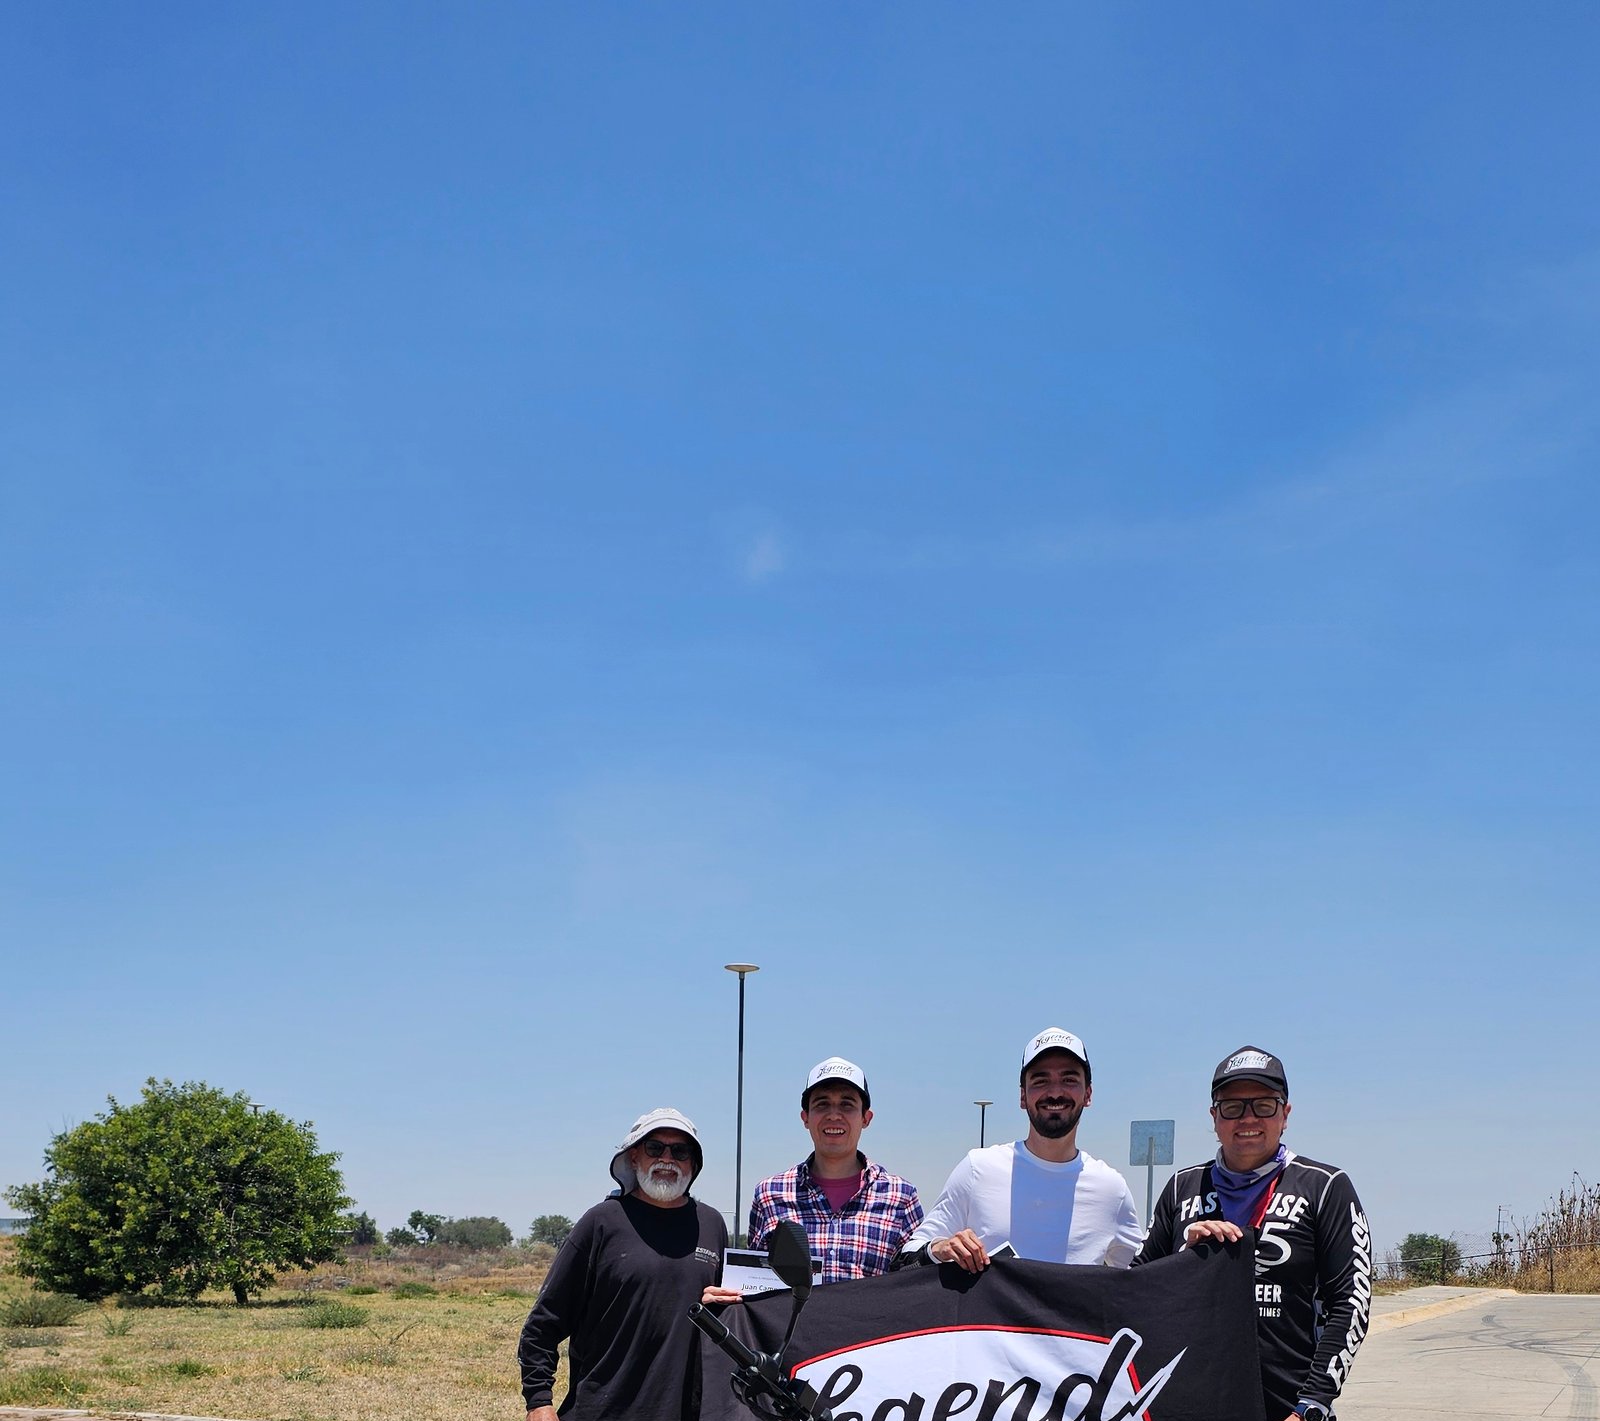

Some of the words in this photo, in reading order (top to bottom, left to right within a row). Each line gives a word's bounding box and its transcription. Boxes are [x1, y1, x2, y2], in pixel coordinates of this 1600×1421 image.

[1180, 1192, 1310, 1223] FASUSE
[741, 1283, 758, 1291] Juan
[759, 1284, 778, 1292] Cam
[1255, 1284, 1282, 1303] EER
[1327, 1202, 1372, 1392] FASTHOUSE
[1258, 1307, 1282, 1318] TIMES
